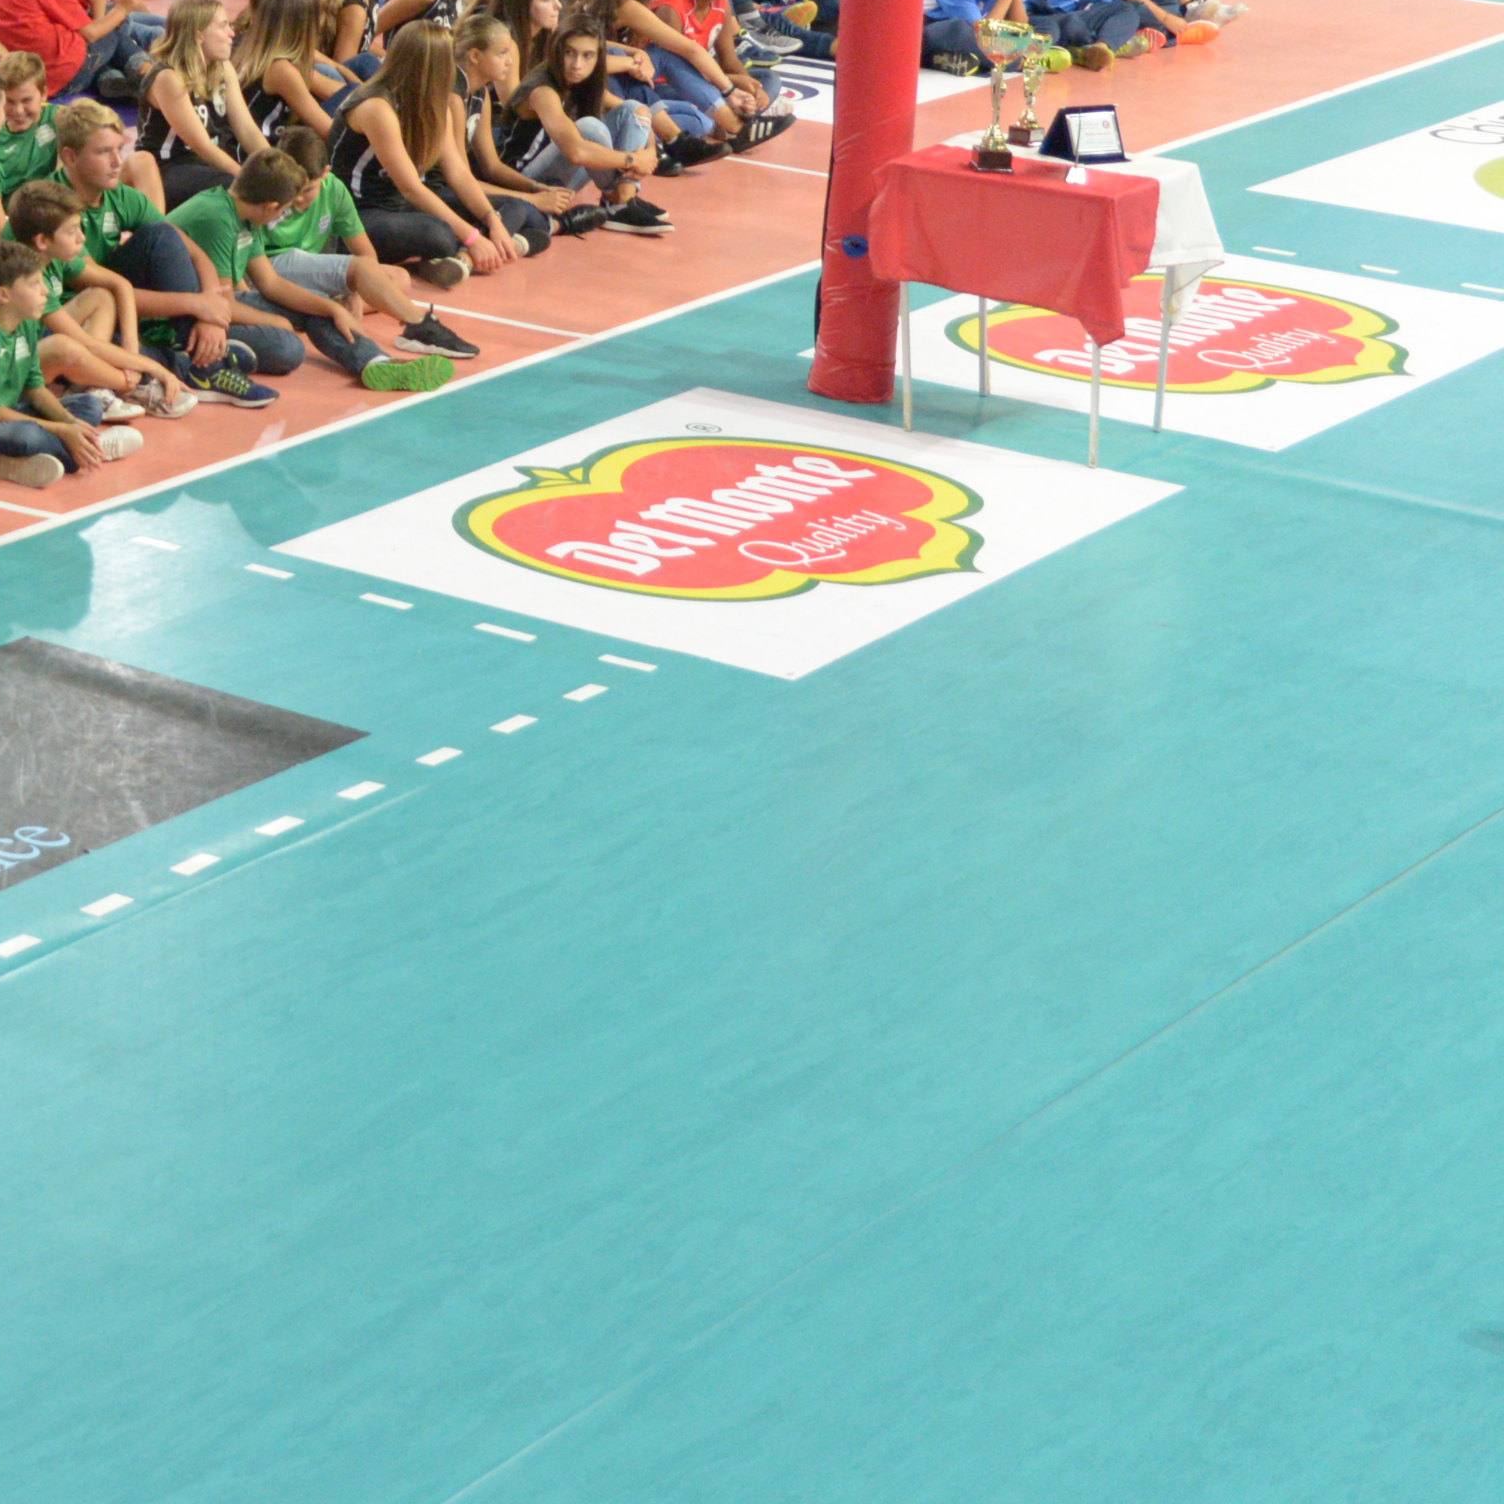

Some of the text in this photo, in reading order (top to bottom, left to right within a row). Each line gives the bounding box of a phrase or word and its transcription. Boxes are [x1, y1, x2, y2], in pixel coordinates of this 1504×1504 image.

[1197, 327, 1337, 370] Quality
[545, 456, 877, 577] Del Monte
[737, 509, 907, 567] Quality
